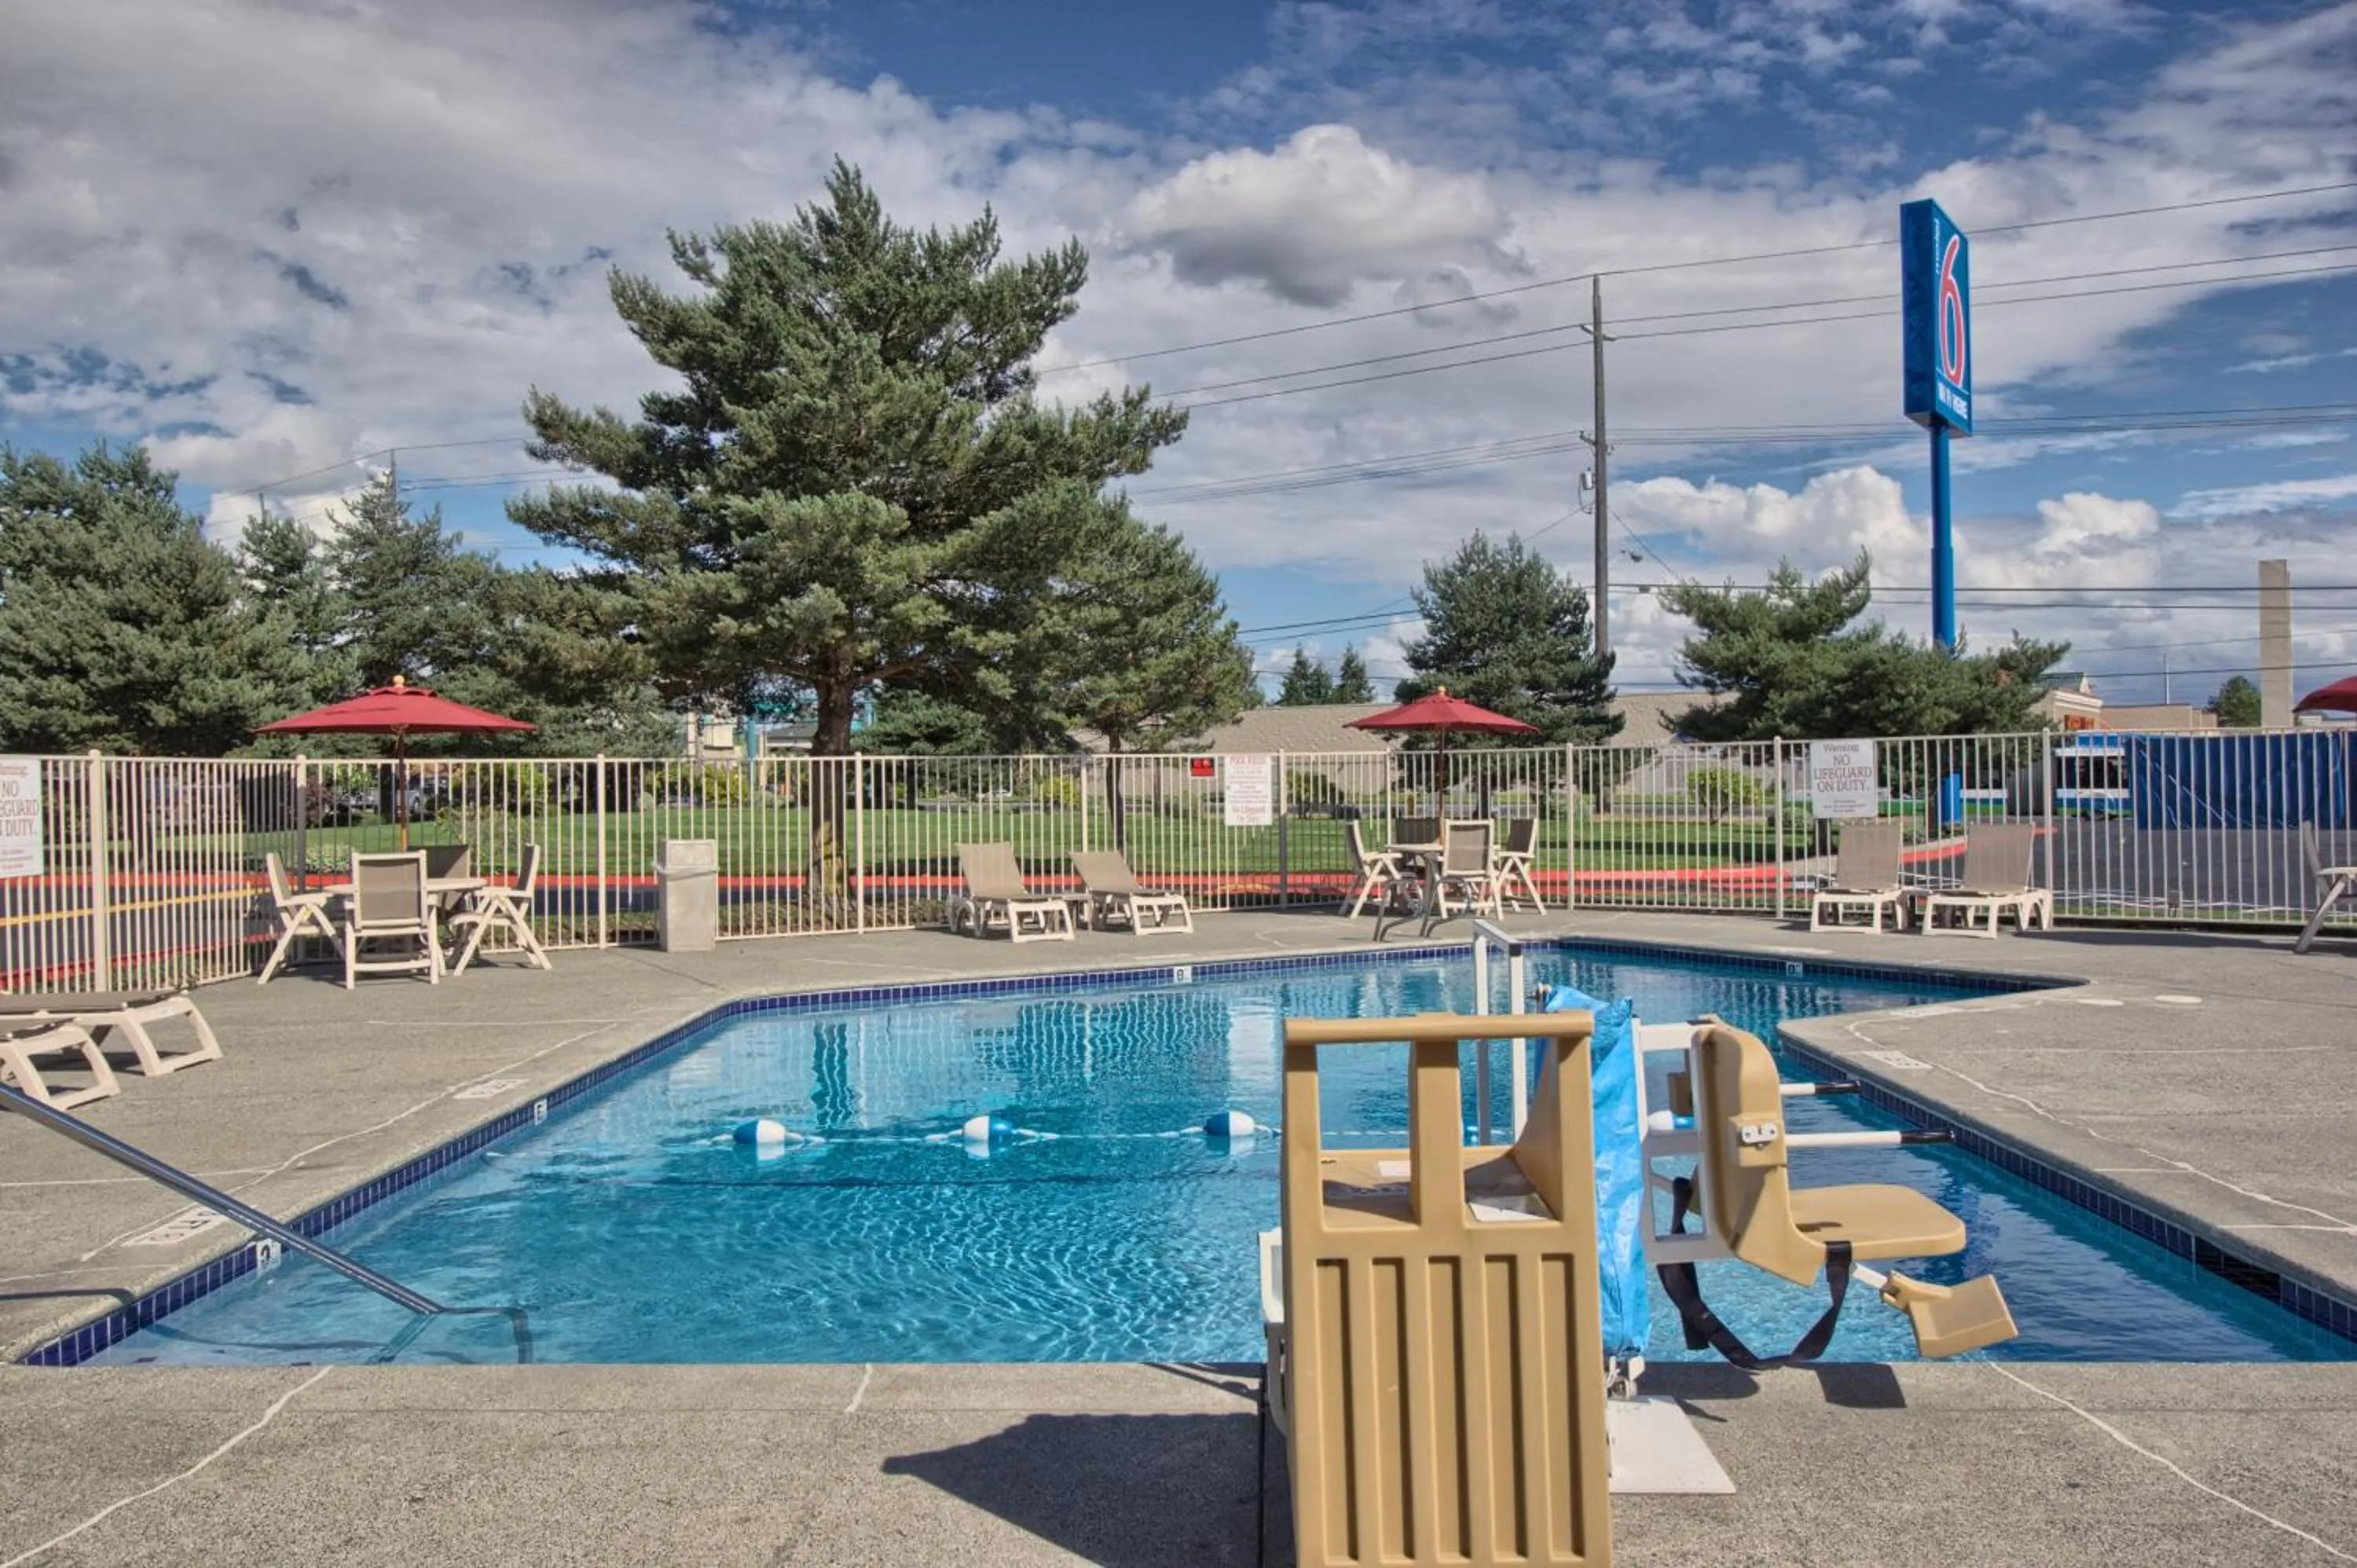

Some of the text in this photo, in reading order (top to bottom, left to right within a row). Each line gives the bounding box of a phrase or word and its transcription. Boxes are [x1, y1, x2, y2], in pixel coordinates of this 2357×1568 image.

[1939, 234, 1964, 388] 6
[1833, 754, 1850, 766] NO
[1813, 767, 1872, 779] LIFEGUARD
[2, 780, 19, 797] NO
[1817, 780, 1835, 792] ON
